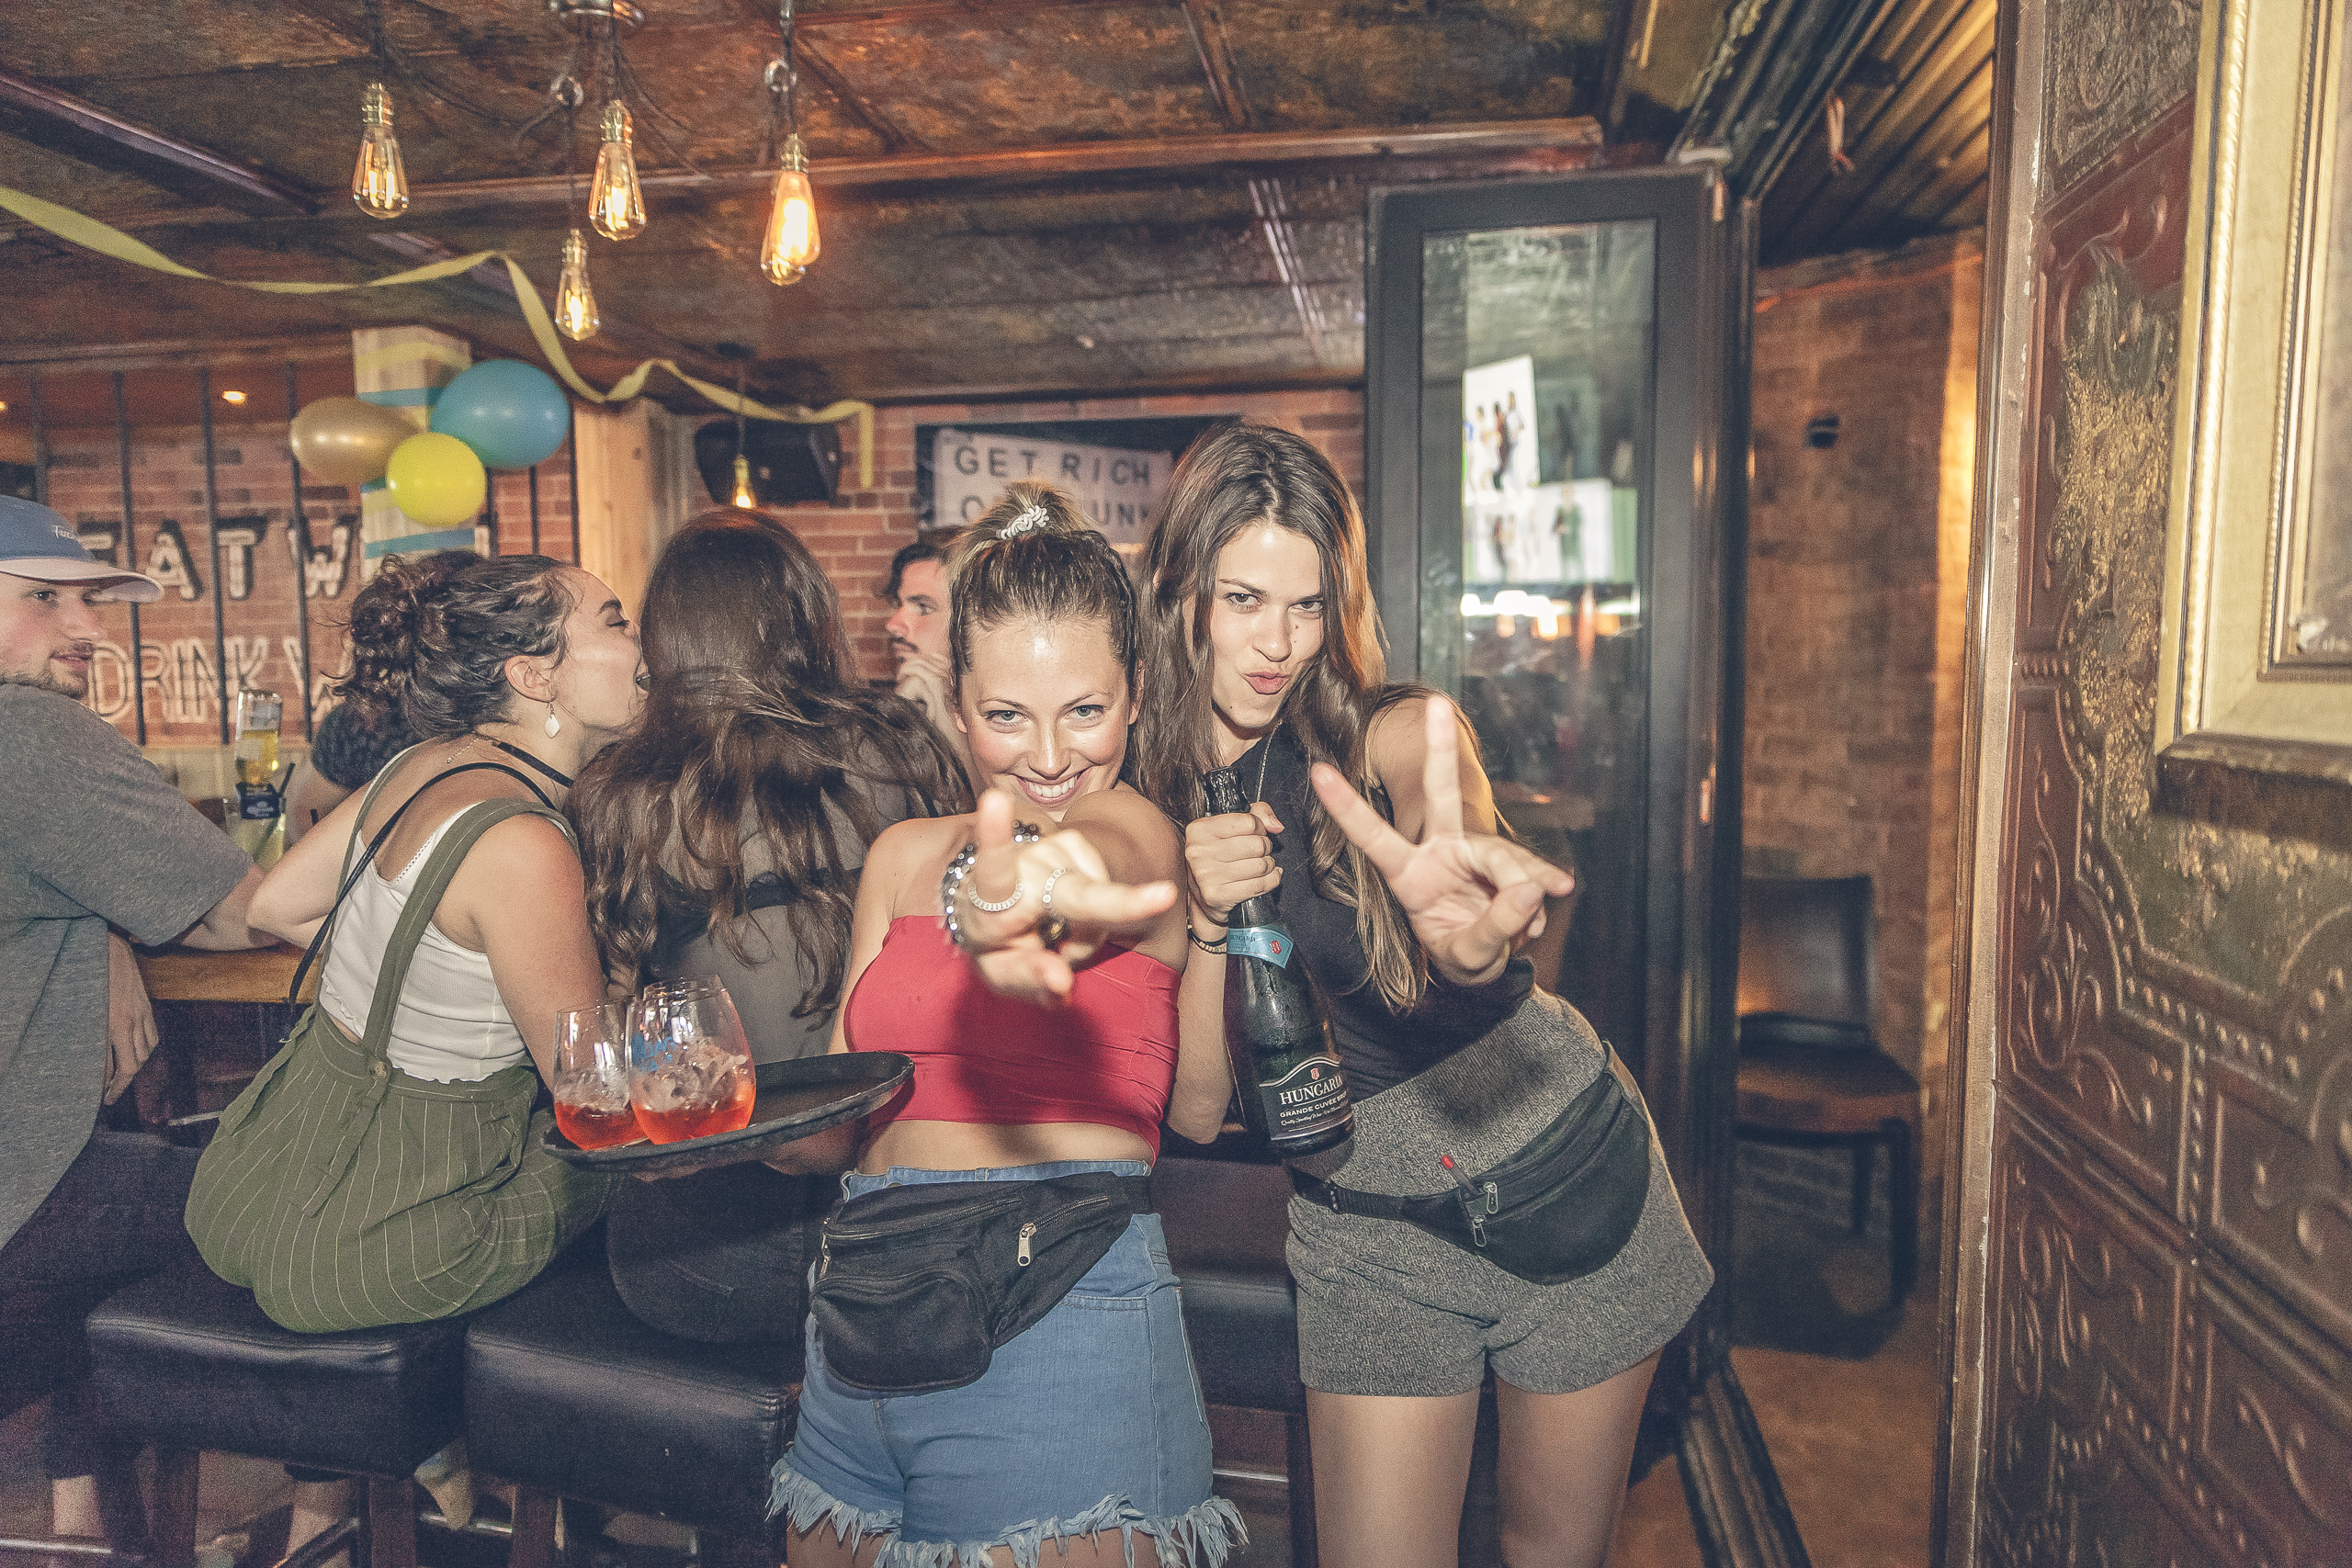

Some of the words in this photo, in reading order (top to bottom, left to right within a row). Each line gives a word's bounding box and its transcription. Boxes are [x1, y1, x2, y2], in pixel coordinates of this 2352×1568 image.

[955, 446, 1038, 477] GET
[1060, 451, 1149, 485] RICH
[88, 635, 269, 726] DRINK
[1279, 1075, 1343, 1105] HUNGARIA
[1280, 1106, 1314, 1118] GRANDE
